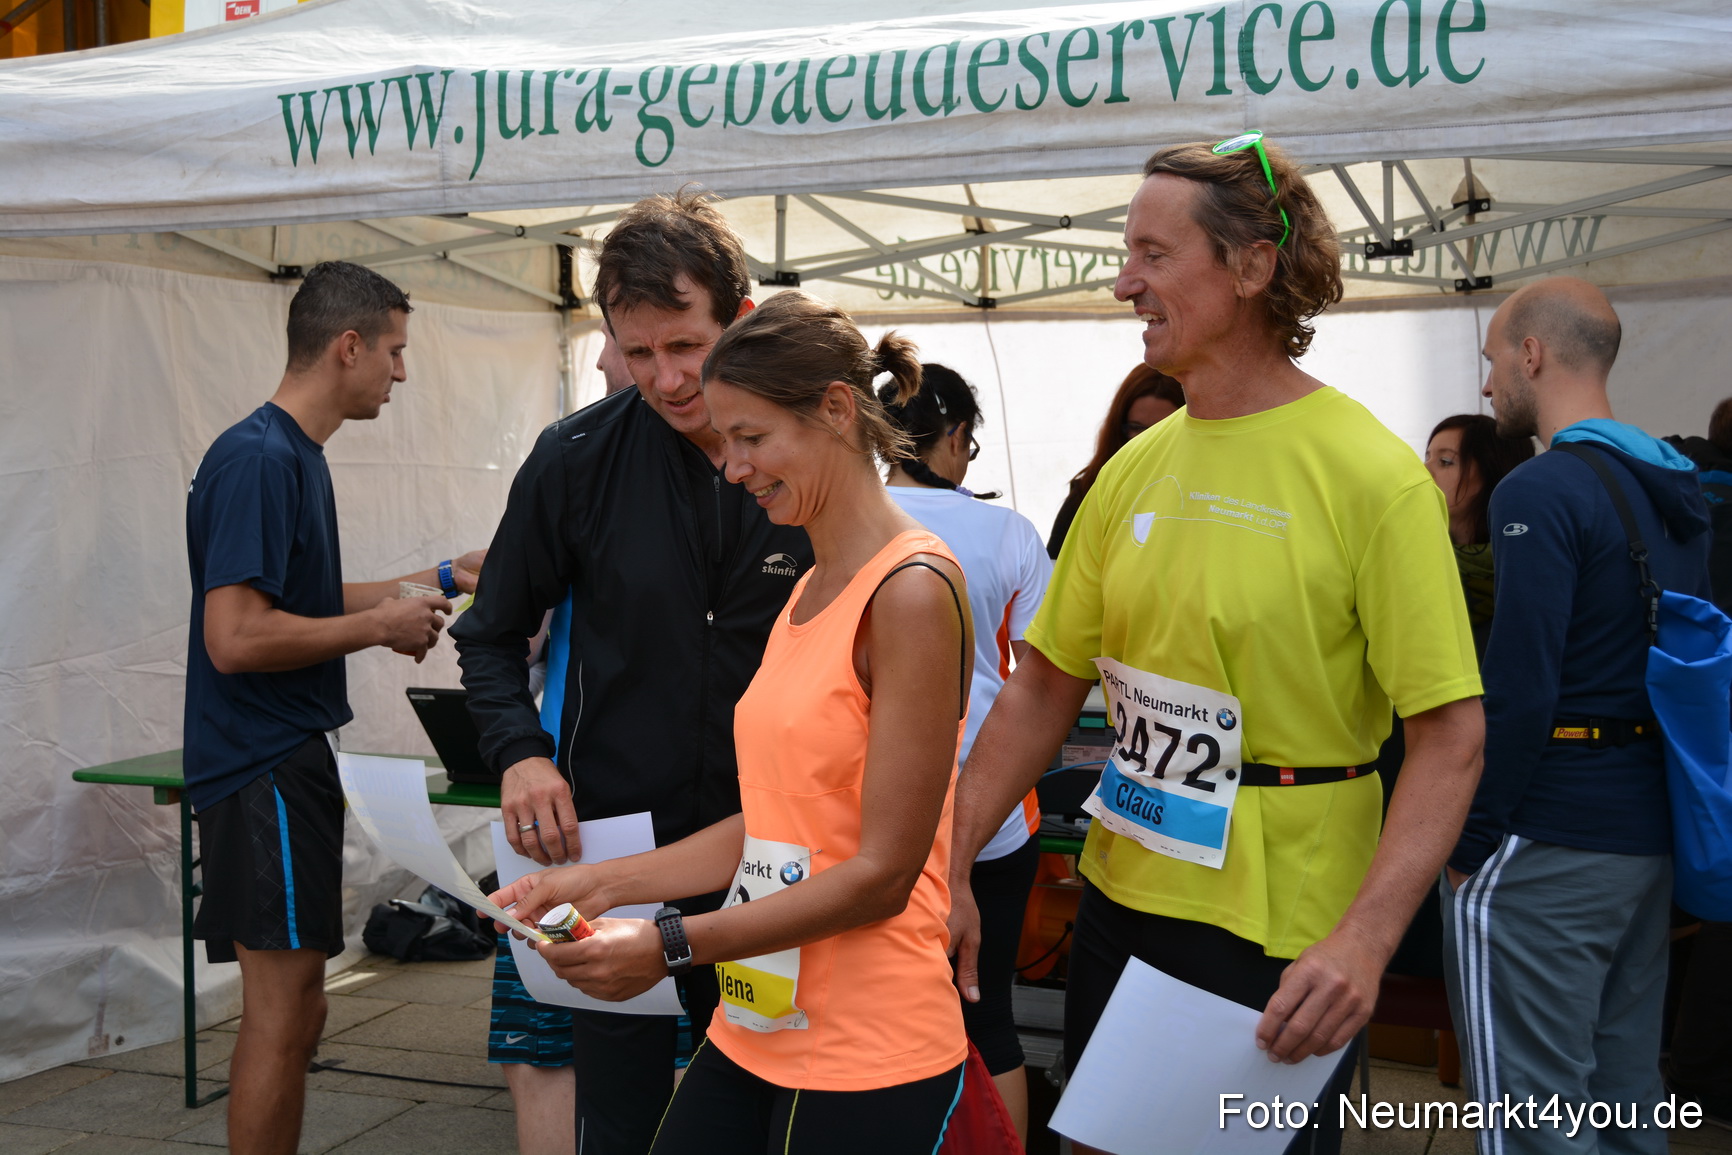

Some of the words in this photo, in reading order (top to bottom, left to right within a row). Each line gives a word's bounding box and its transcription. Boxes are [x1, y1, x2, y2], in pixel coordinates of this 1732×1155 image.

[1209, 505, 1254, 521] Neumarkt
[1223, 496, 1240, 506] des
[1241, 499, 1292, 519] Landkreises
[762, 565, 796, 577] skinfit
[1133, 687, 1209, 723] Neumarkt
[1116, 782, 1164, 825] Claus
